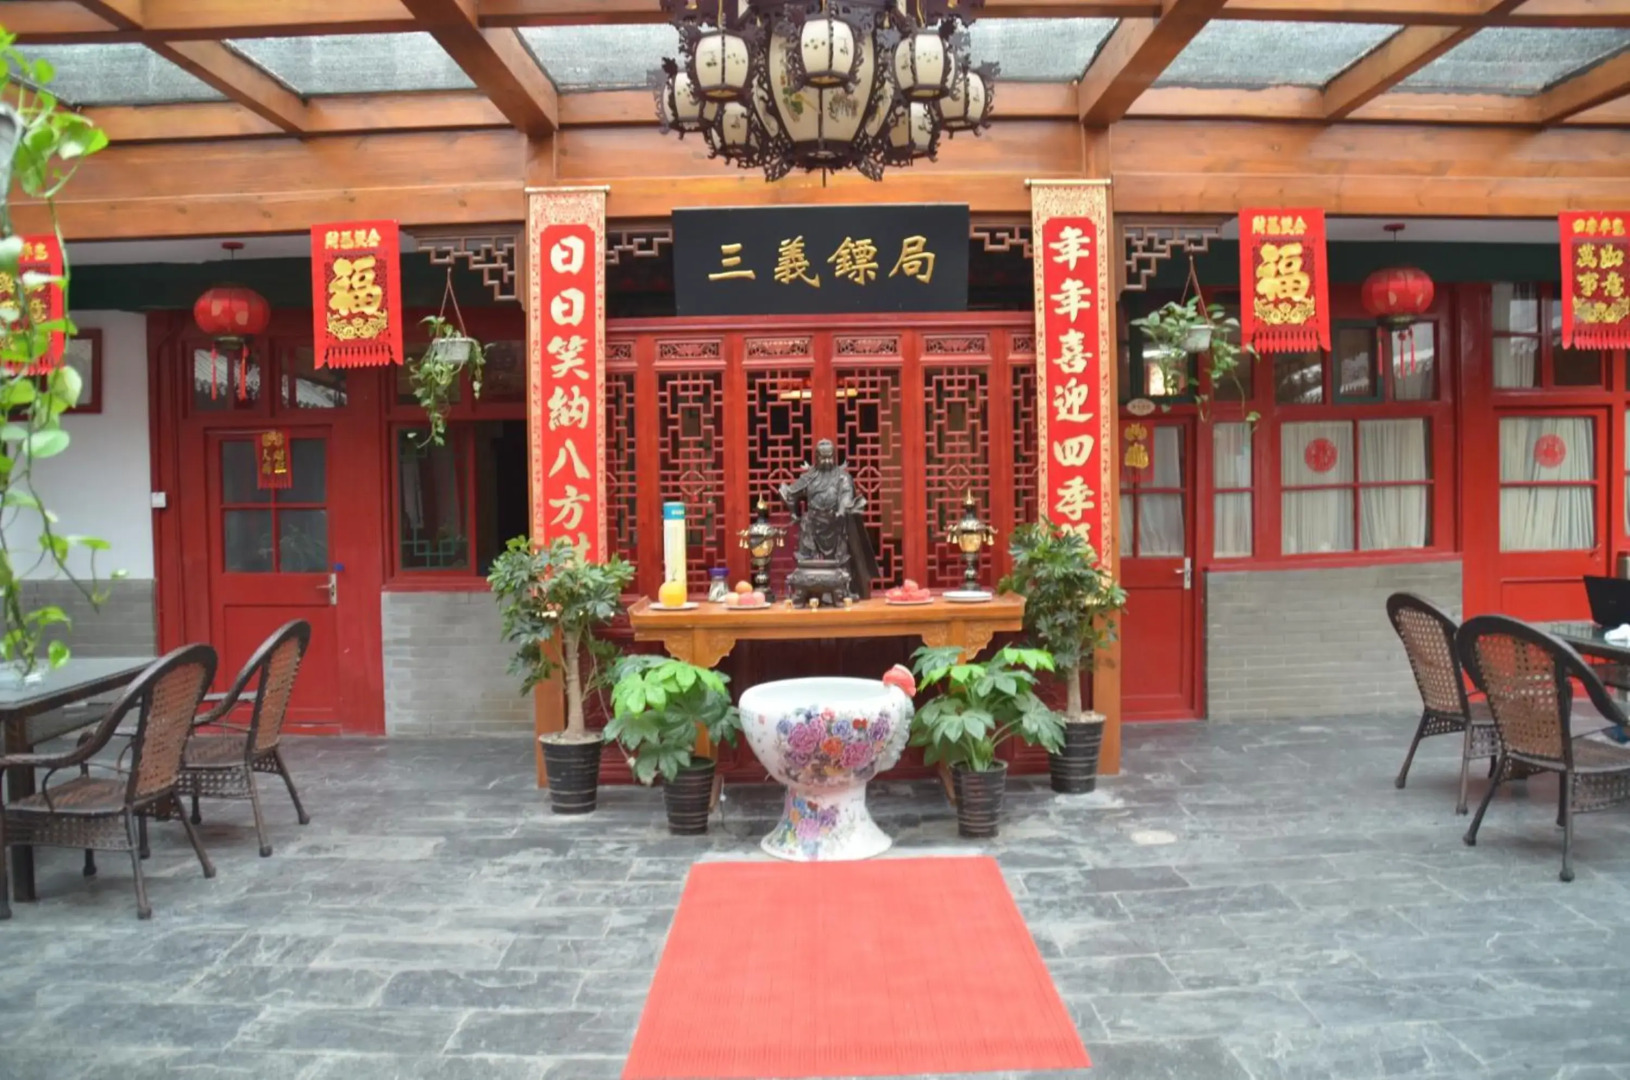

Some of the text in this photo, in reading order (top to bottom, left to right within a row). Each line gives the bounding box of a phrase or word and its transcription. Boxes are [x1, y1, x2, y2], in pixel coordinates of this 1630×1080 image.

[329, 255, 383, 316] 福
[708, 235, 936, 288] 三義鏢局
[1256, 242, 1310, 301] 福
